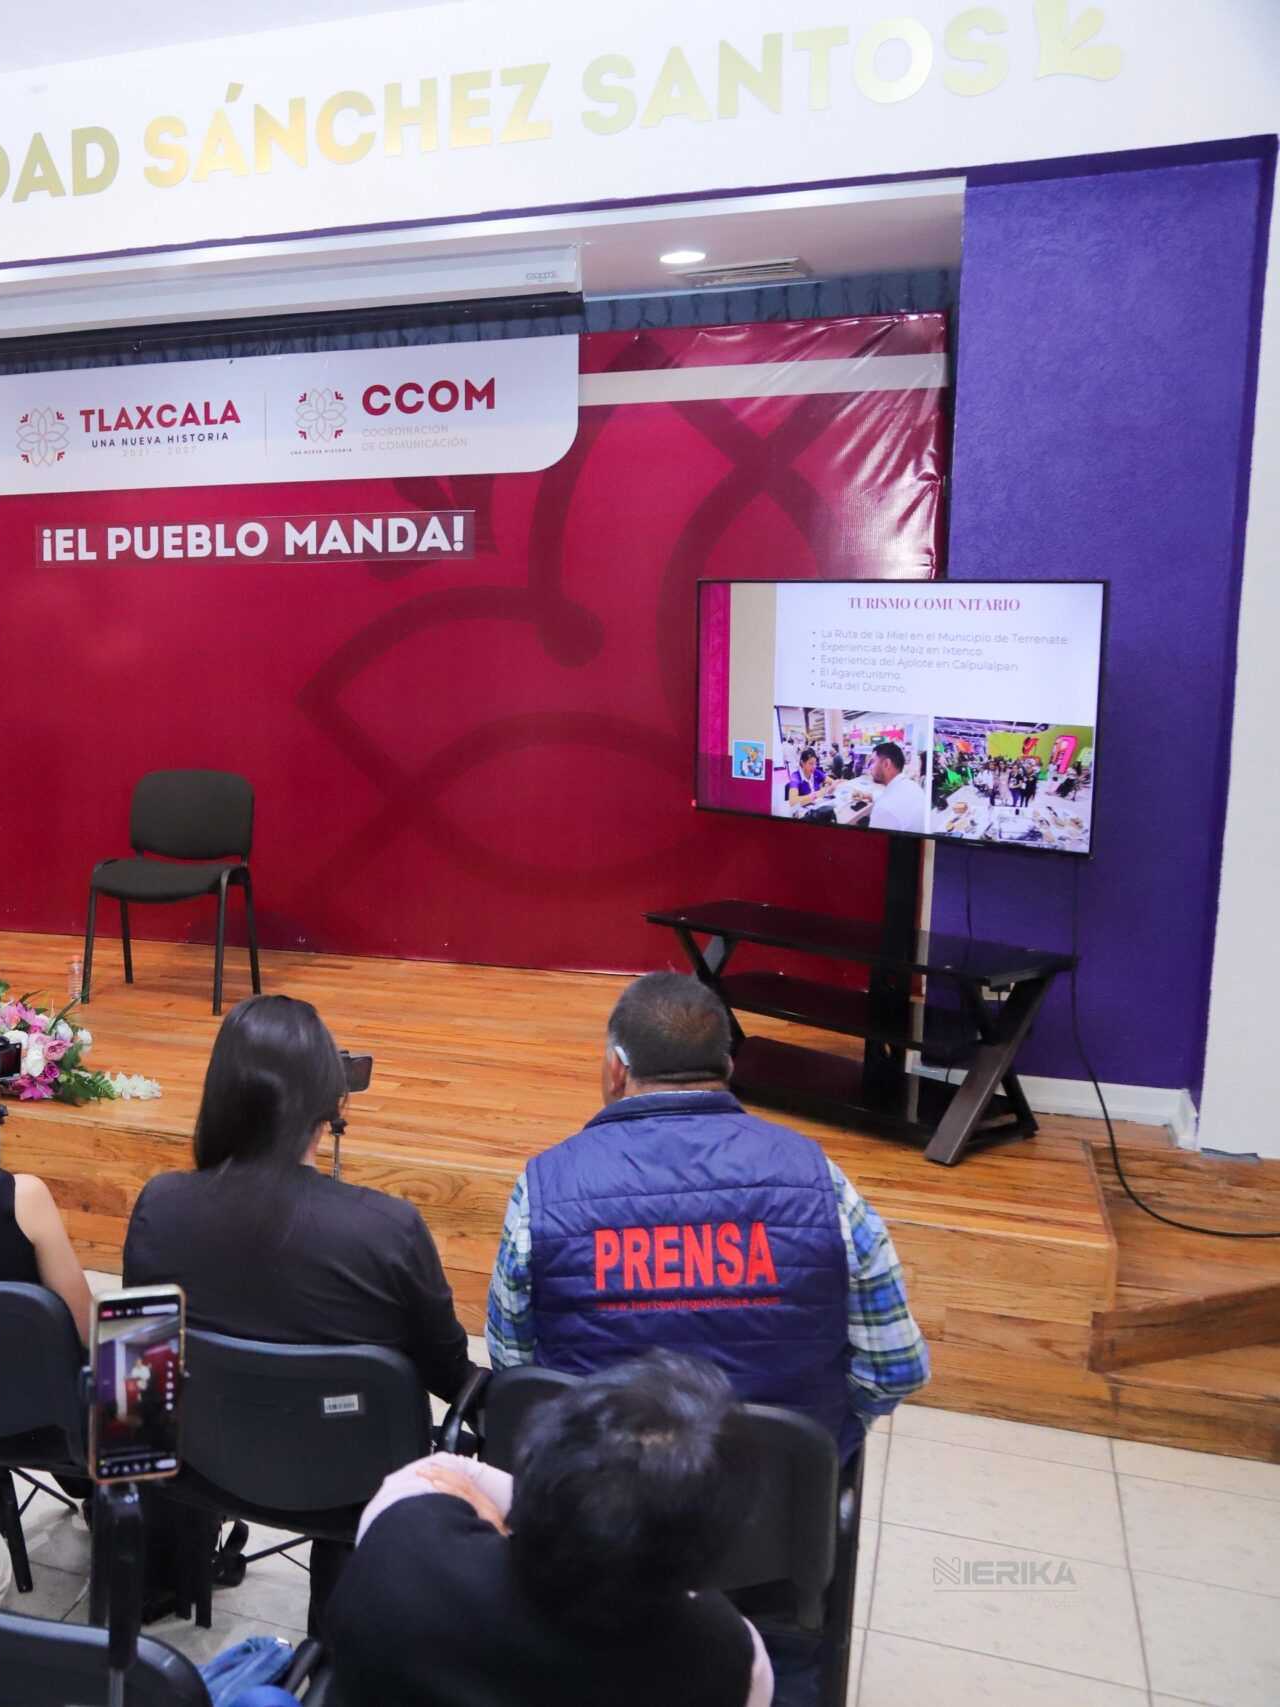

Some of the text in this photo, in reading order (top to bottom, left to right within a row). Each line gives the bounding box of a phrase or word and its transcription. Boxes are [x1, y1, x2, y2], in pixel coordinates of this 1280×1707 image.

[143, 62, 552, 188] SÁNCHEZ
[580, 6, 1011, 136] SANTOS
[362, 377, 496, 416] CCOM
[79, 400, 241, 433] TLAXCALA
[91, 432, 229, 448] UNA NUEVA HISTORIA
[42, 516, 465, 561] ¡EL PUEBLO MANDA!
[848, 597, 1021, 611] TURISMO COMUNITARIO
[835, 629, 859, 639] Ruta
[861, 630, 873, 639] de
[938, 632, 992, 645] Municipio
[994, 633, 1008, 643] de
[821, 642, 882, 654] Experiencias
[885, 644, 897, 653] de
[821, 655, 877, 666] Experiencia
[880, 657, 895, 666] del
[820, 680, 842, 690] Ruta
[594, 1221, 779, 1290] PRENSA
